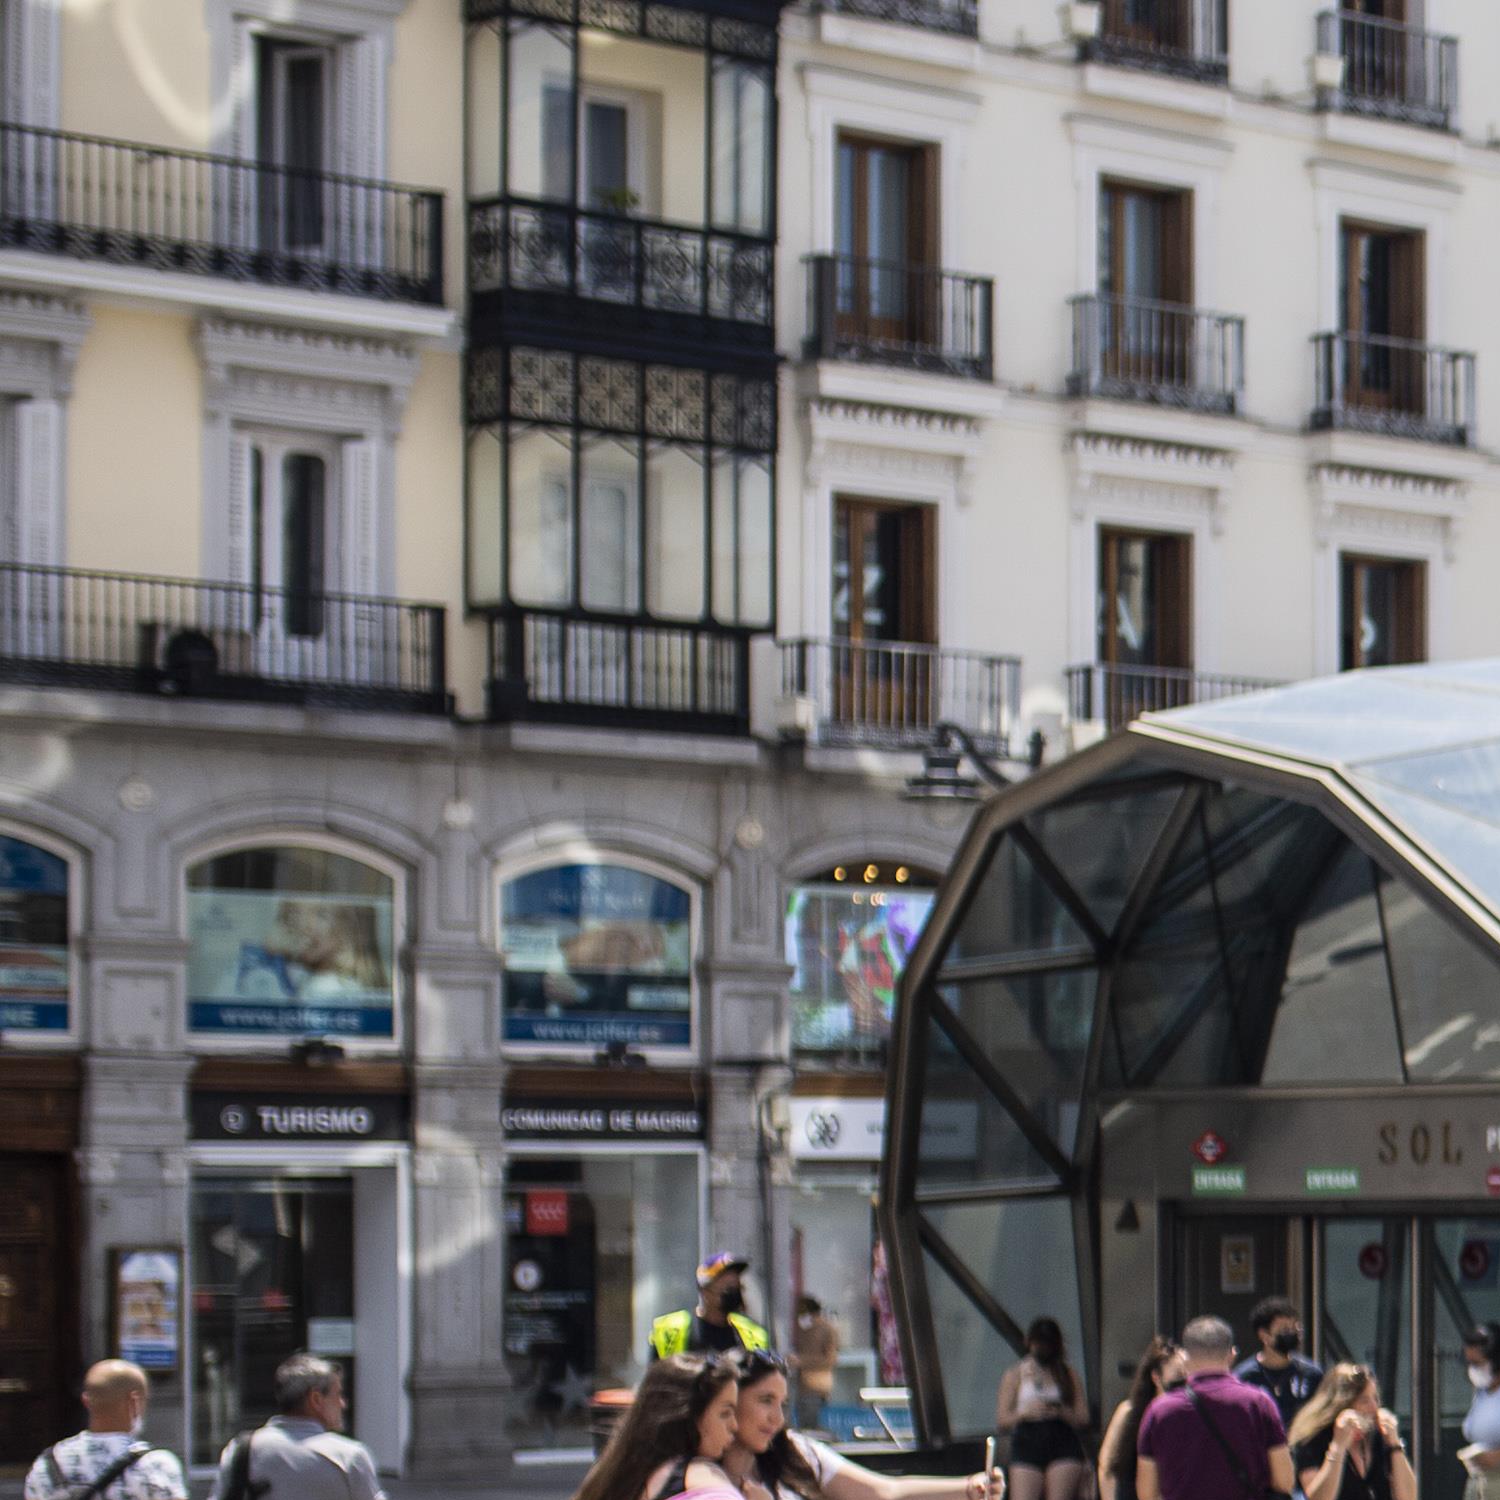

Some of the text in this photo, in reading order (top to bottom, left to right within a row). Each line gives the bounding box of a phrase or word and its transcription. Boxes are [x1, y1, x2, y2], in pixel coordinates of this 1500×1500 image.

[257, 1106, 373, 1133] TURISMO
[502, 1109, 701, 1132] COMUNIDAD DE MADRID
[1379, 1119, 1462, 1166] SOL
[1194, 1169, 1243, 1190] ENTRADA
[1306, 1169, 1356, 1189] ENTRADA
